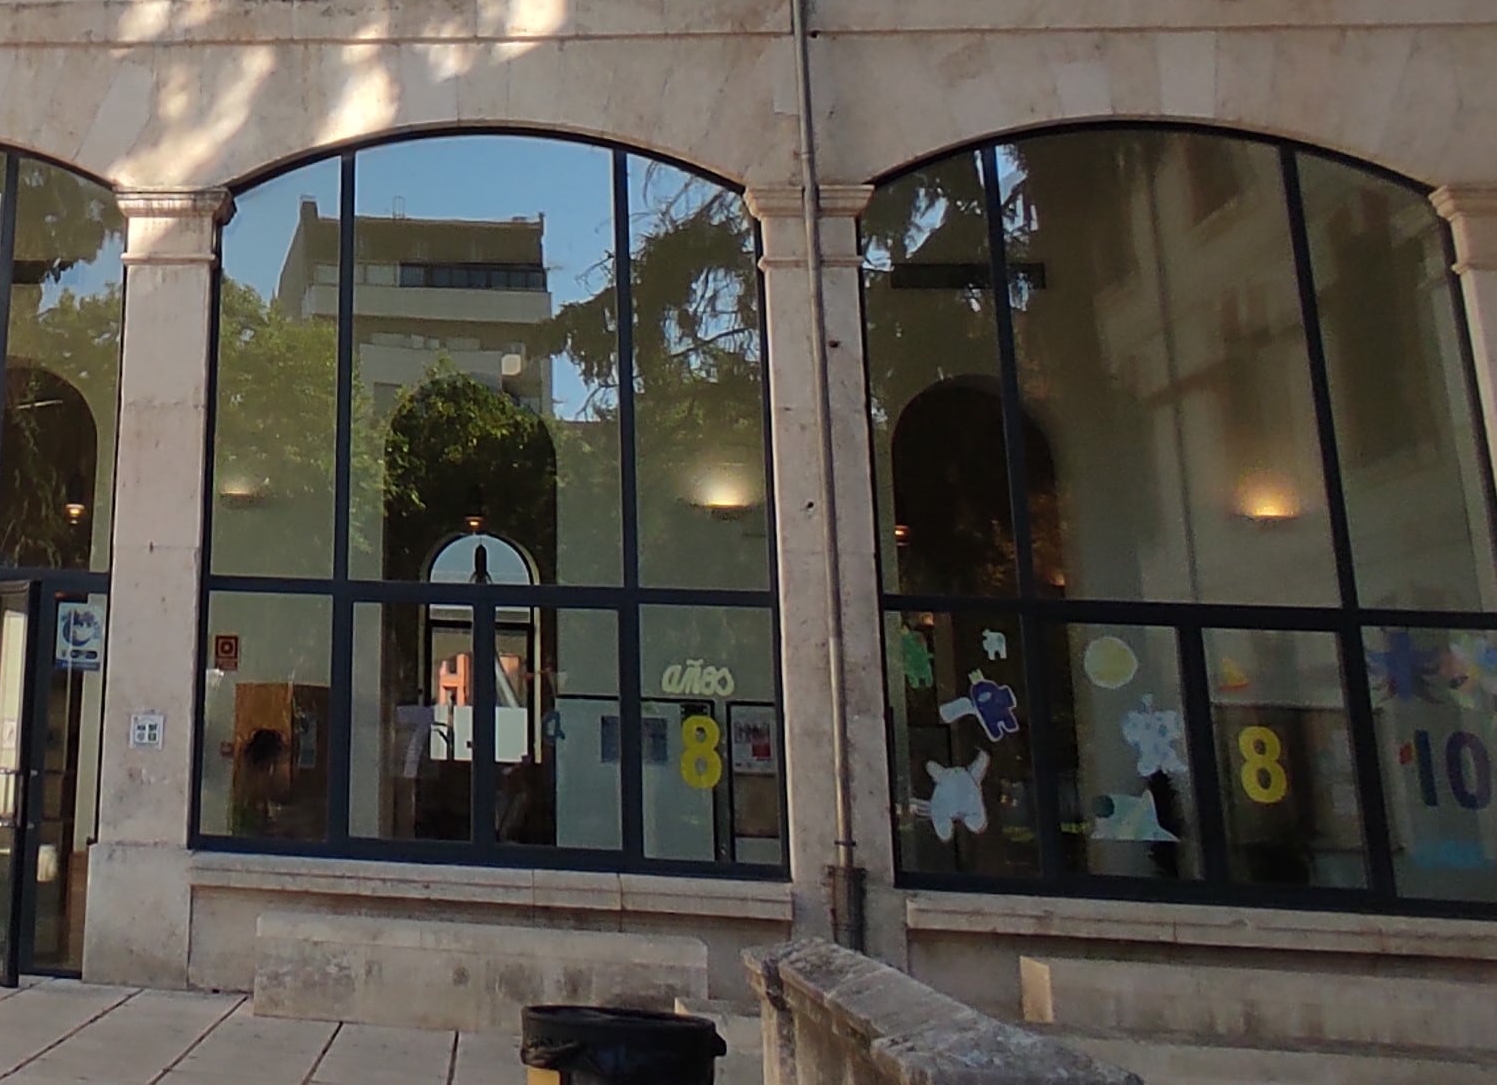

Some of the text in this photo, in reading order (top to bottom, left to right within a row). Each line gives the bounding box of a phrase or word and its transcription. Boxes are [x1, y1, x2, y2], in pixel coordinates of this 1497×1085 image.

[661, 658, 735, 696] años
[680, 715, 723, 790] 8
[1238, 726, 1288, 803] 8
